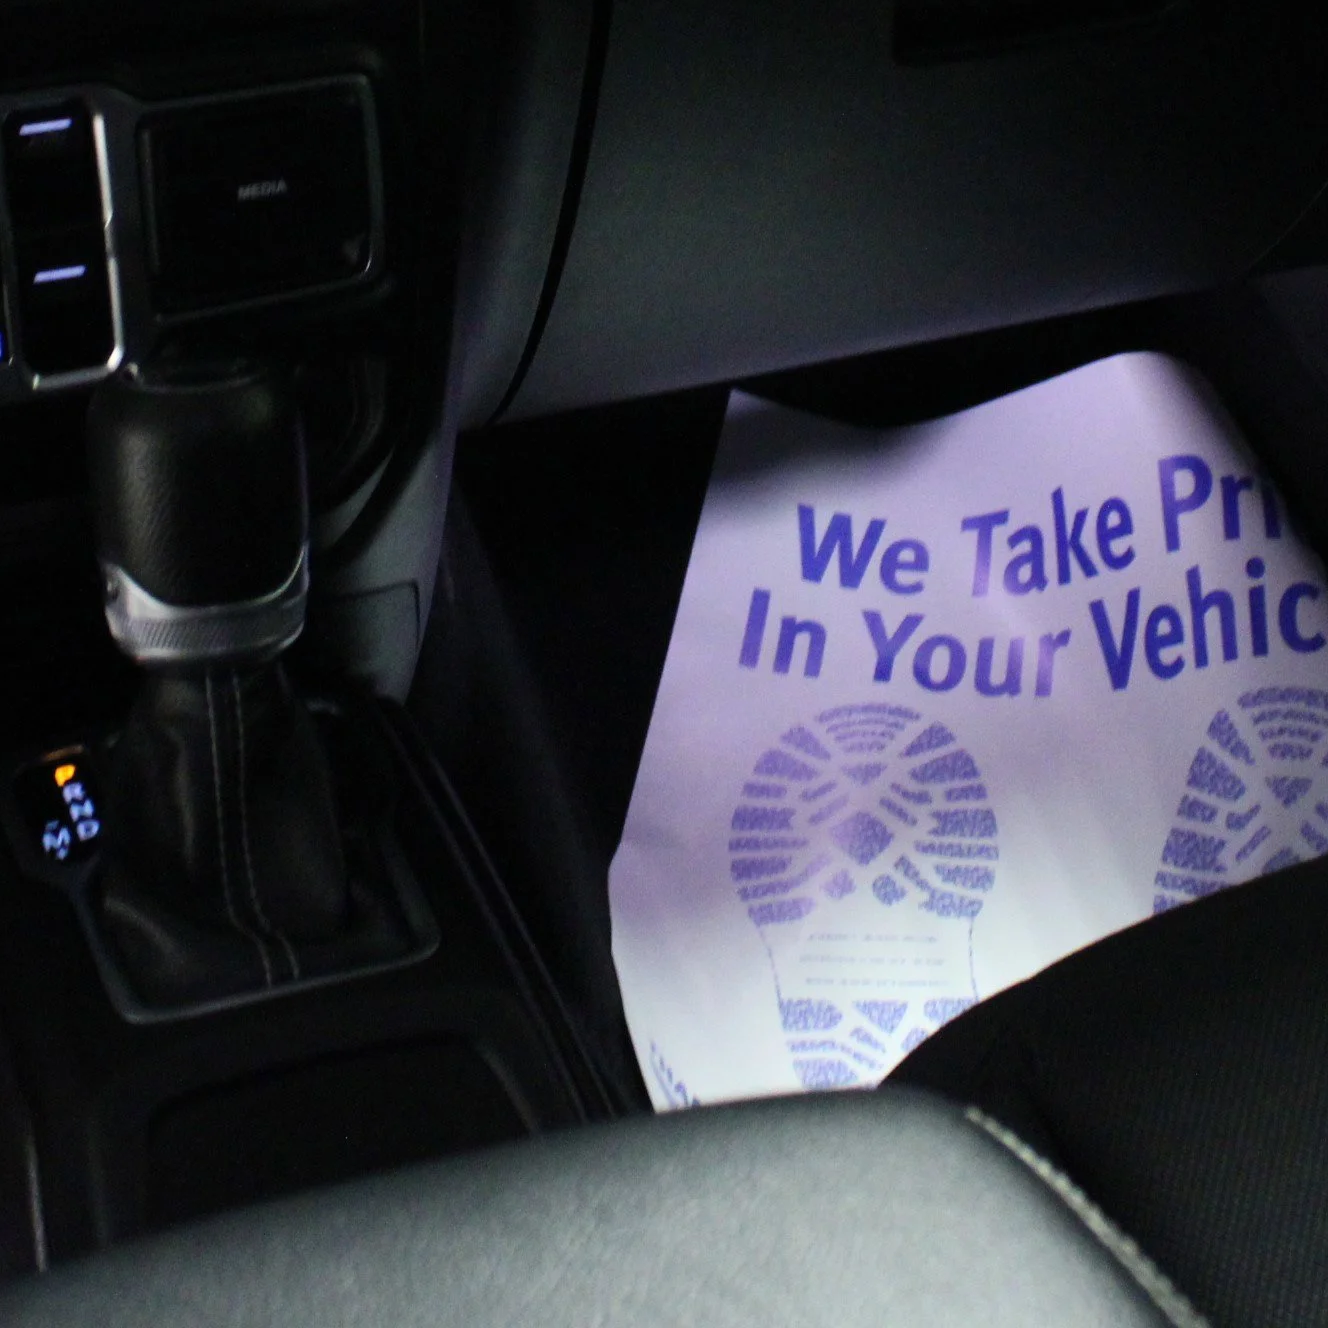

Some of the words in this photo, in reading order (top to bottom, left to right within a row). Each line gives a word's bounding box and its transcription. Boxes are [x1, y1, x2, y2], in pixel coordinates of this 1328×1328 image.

[798, 504, 930, 595] We
[961, 487, 1136, 598] Take
[738, 588, 828, 678] In
[862, 610, 1071, 698] Your
